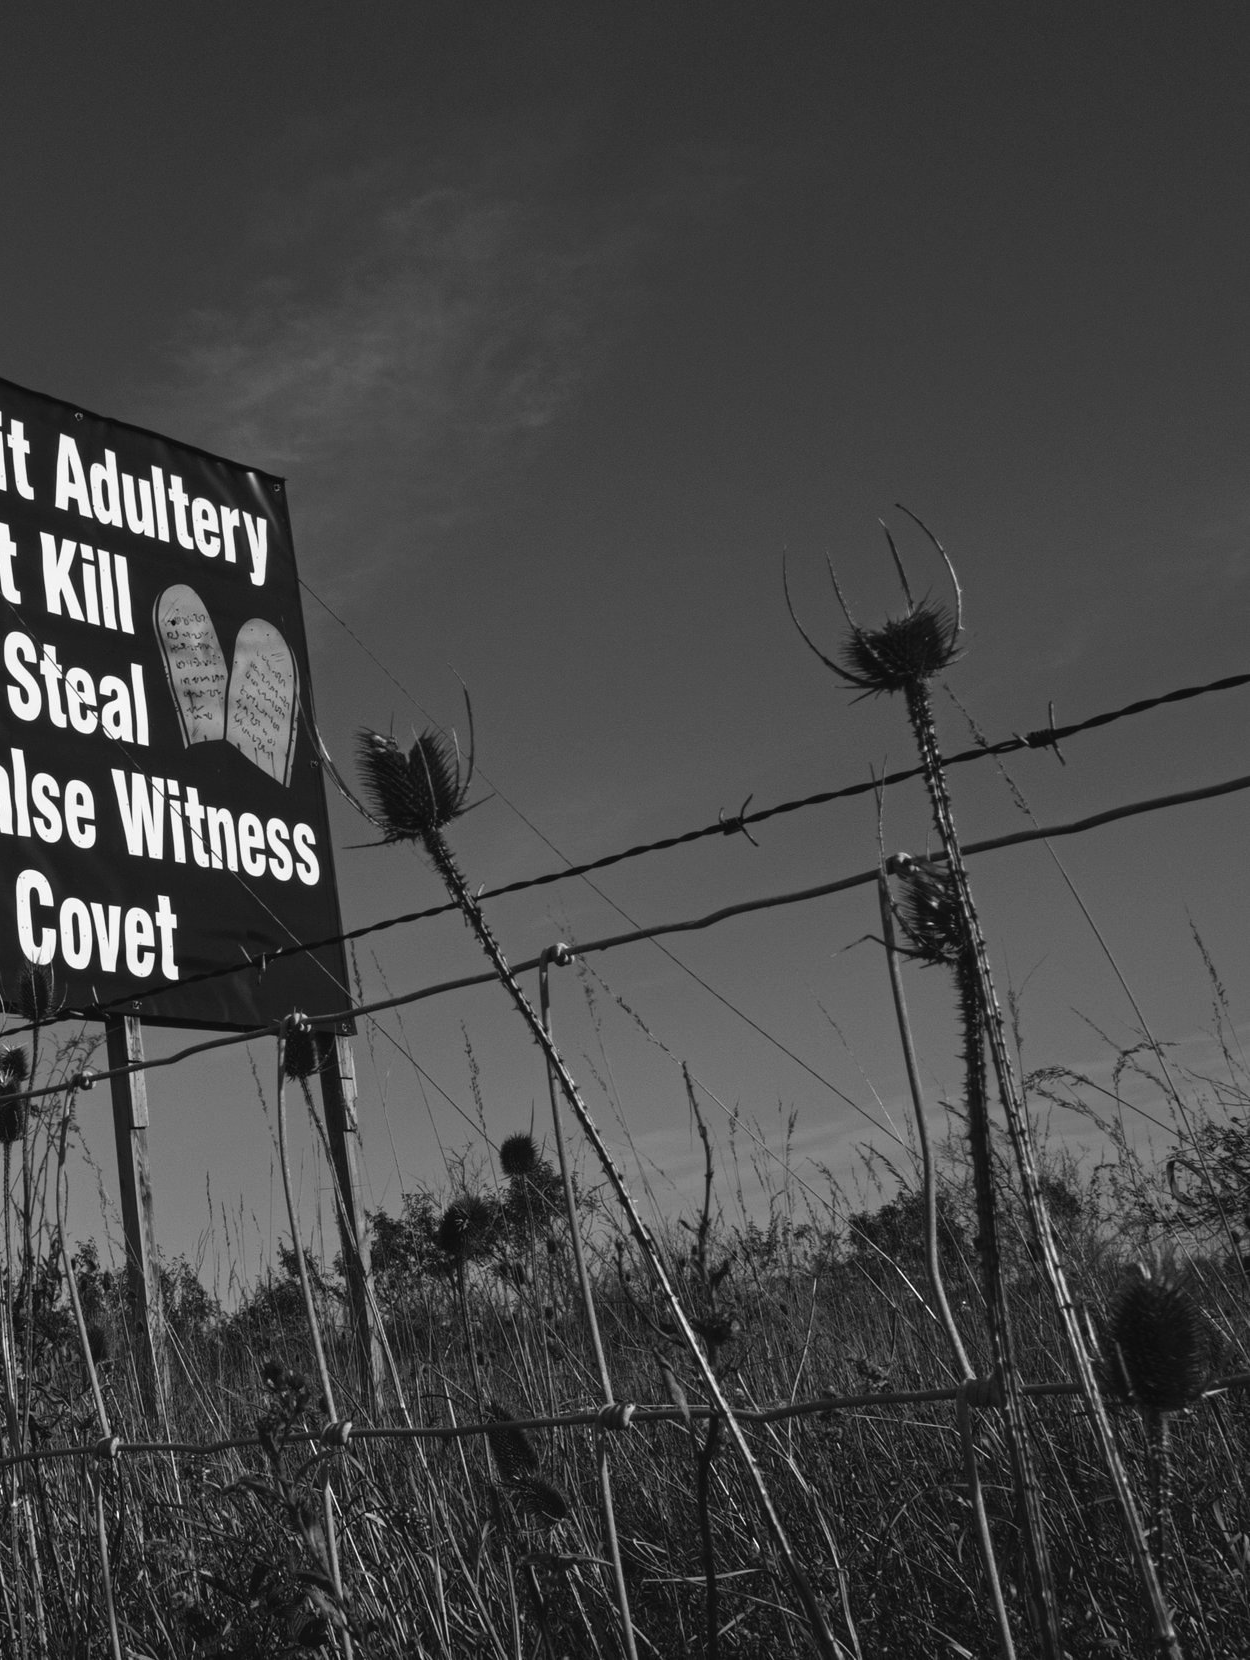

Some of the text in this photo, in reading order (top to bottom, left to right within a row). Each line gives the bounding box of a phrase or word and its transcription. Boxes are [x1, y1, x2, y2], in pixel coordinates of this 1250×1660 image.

[55, 434, 267, 586] Adultery
[40, 532, 134, 634] Kill
[4, 632, 149, 746] Steal
[111, 769, 320, 886] Witness
[16, 870, 178, 980] Covet
